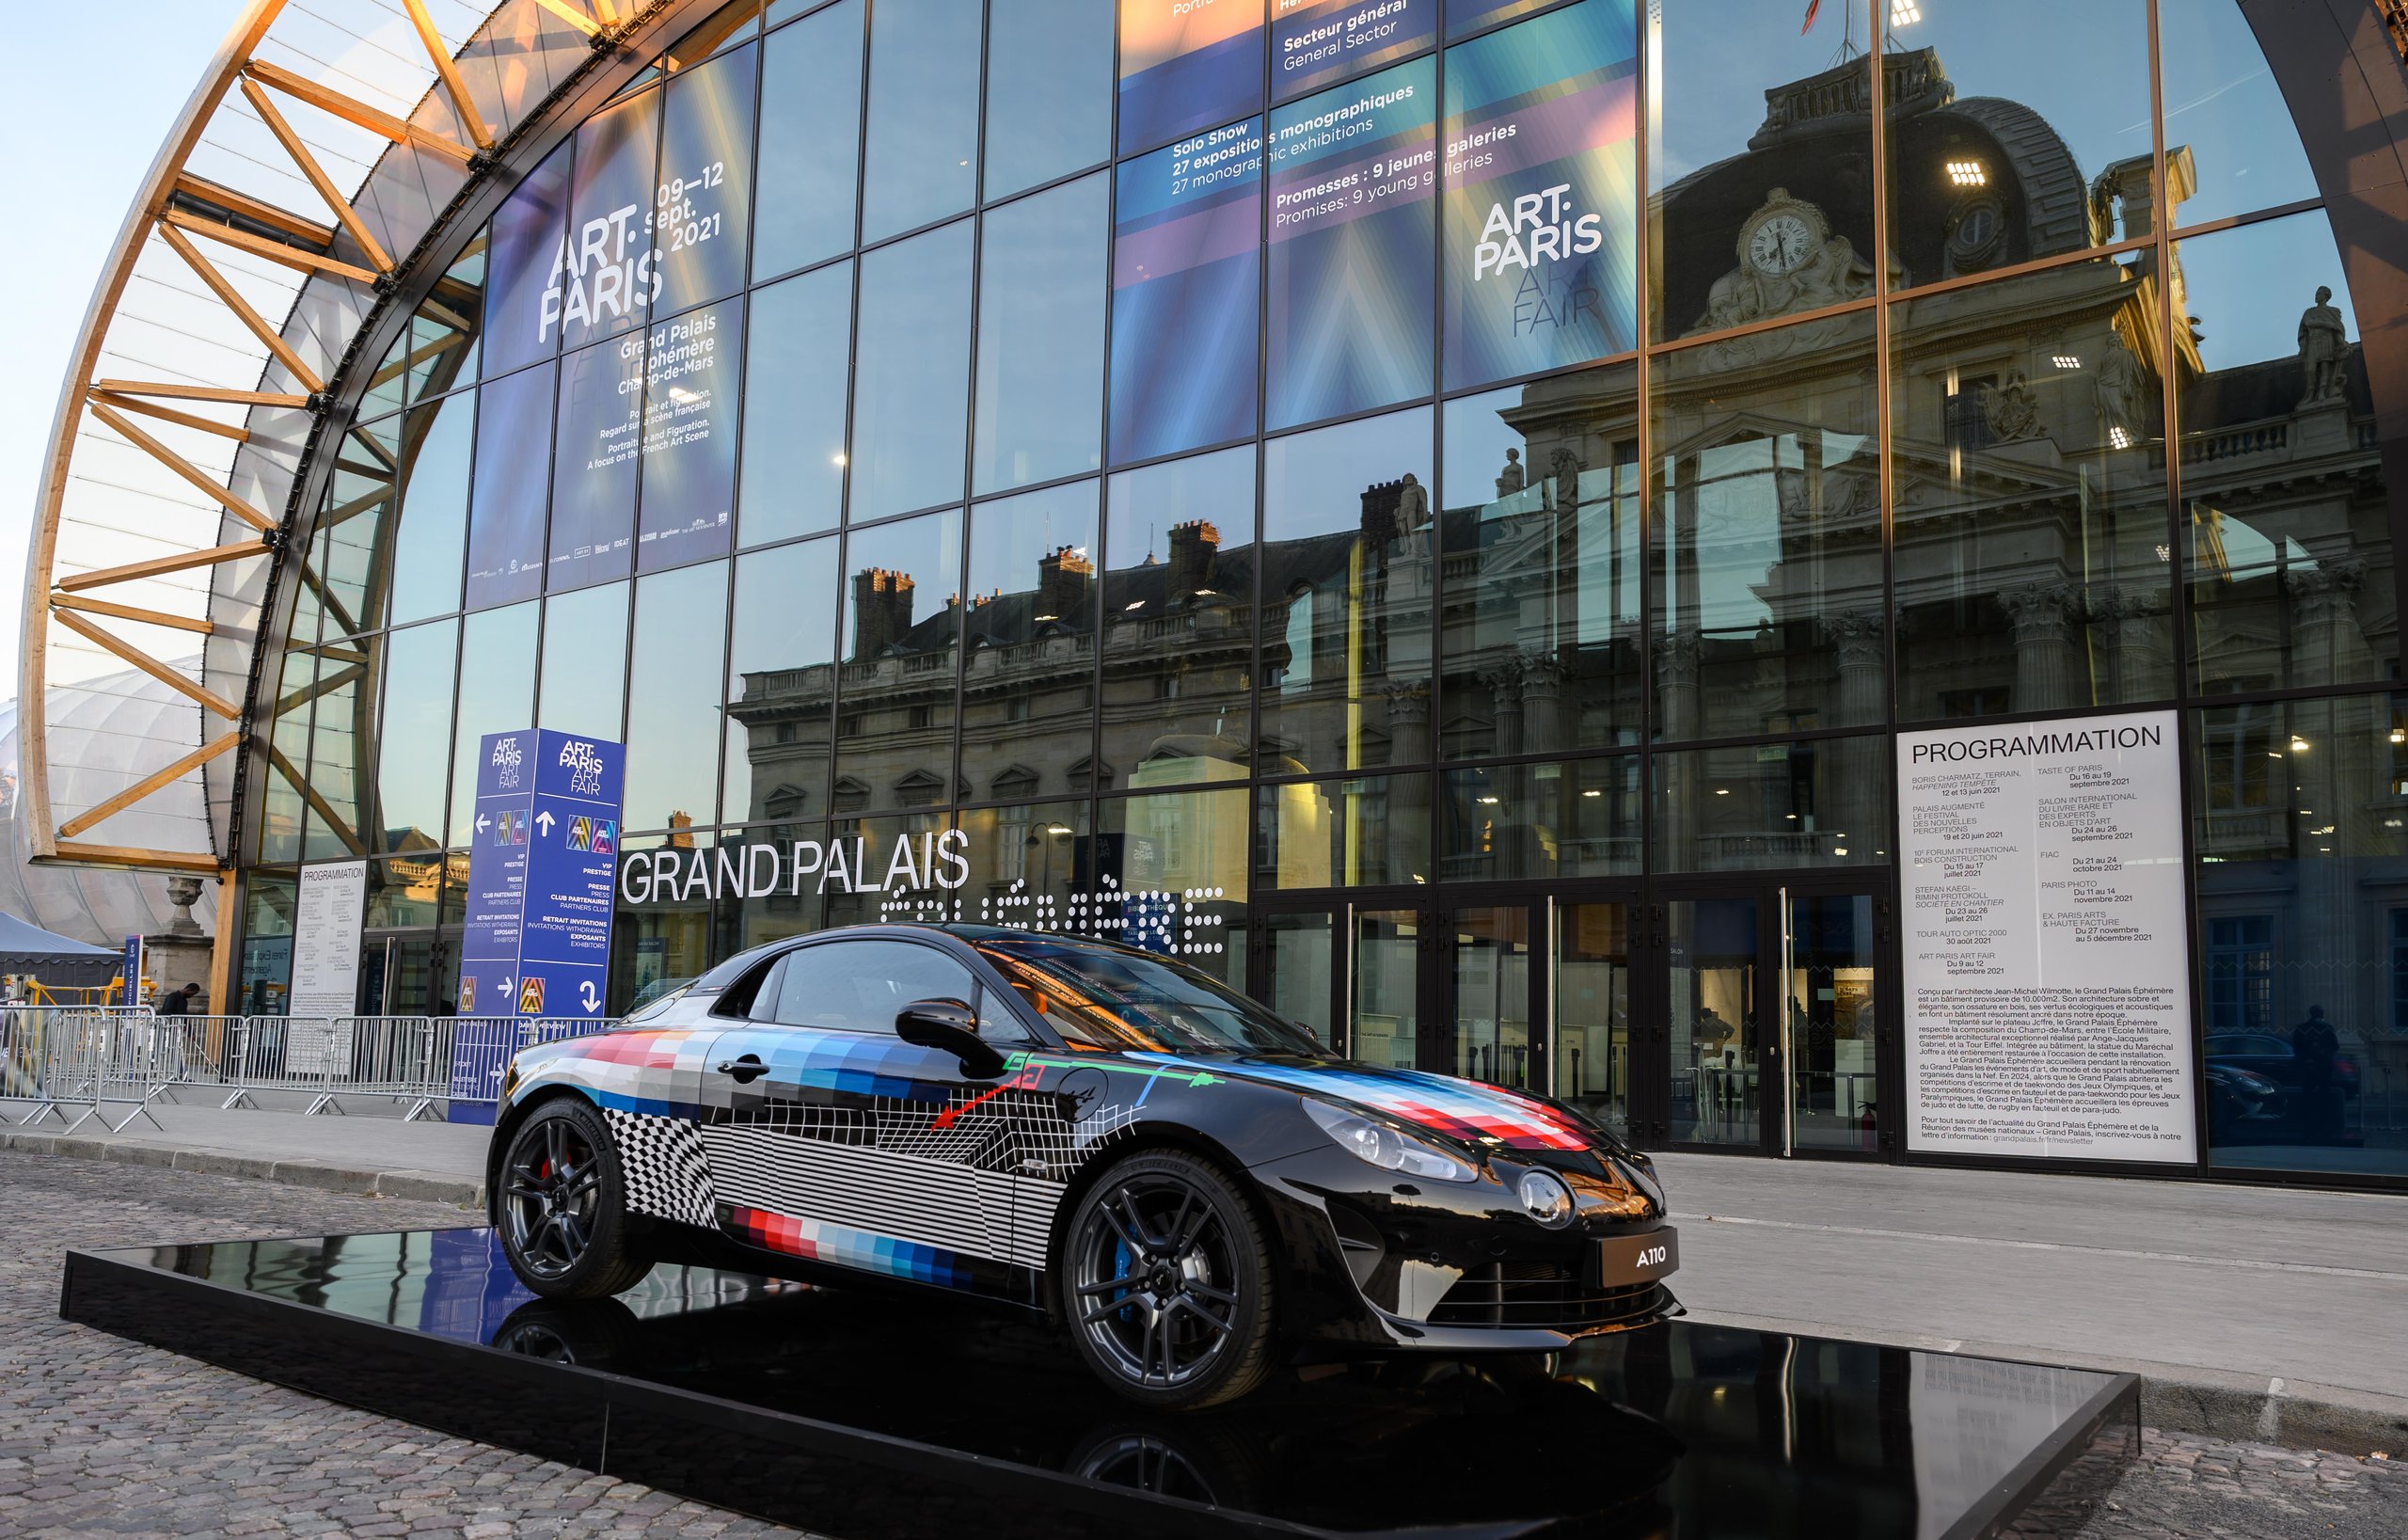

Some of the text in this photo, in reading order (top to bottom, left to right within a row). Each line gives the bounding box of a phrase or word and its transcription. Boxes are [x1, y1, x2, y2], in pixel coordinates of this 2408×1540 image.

[1284, 0, 1406, 53] Secteur général
[1285, 20, 1397, 71] General Sector
[1173, 85, 1414, 176] 27 expositios monographiques
[1174, 124, 1247, 157] Solo Show
[1172, 179, 1188, 195] 27
[1291, 119, 1372, 155] exhibitions
[1276, 172, 1358, 208] Promesses
[1373, 164, 1383, 179] 9
[1448, 124, 1516, 157] galeries
[1276, 153, 1492, 228] Promises: 9 young glleries
[644, 197, 695, 234] sept.
[671, 213, 720, 252] 2021
[1474, 214, 1602, 280] PARIS
[1514, 250, 1599, 304] ART
[539, 249, 662, 343] PARIS
[1513, 288, 1598, 338] FAIR
[621, 314, 716, 359] Grand Palais
[600, 400, 710, 439] Regard sur scène française
[630, 401, 668, 420] Porait et
[587, 430, 709, 470] A focus on the French Art Scene
[608, 420, 709, 453] Portraitue and Figuration.
[493, 750, 521, 767] PARIS
[1912, 725, 2161, 764] PROGRAMMATION
[500, 764, 518, 777] ART
[560, 753, 603, 772] PARIS
[573, 769, 601, 784] ART
[499, 775, 519, 788] FAIR
[571, 780, 600, 796] FAIR
[2070, 780, 2110, 788] septembre
[2069, 794, 2136, 803] INTERNATIONAL
[1913, 826, 1968, 834] PERCEPTIONS
[305, 867, 363, 881] PROGRAMMATION
[621, 829, 970, 905] GRAND PALAIS
[1935, 854, 1997, 863] CONSTRUCTION
[568, 897, 609, 905] PARTENAIRES
[566, 926, 606, 934] WITHDRAWAL
[570, 918, 607, 927] INVITATIONS
[571, 941, 605, 949] EXHIBITORS
[2133, 986, 2173, 995] Éphémère
[1637, 1246, 1666, 1268] A110
